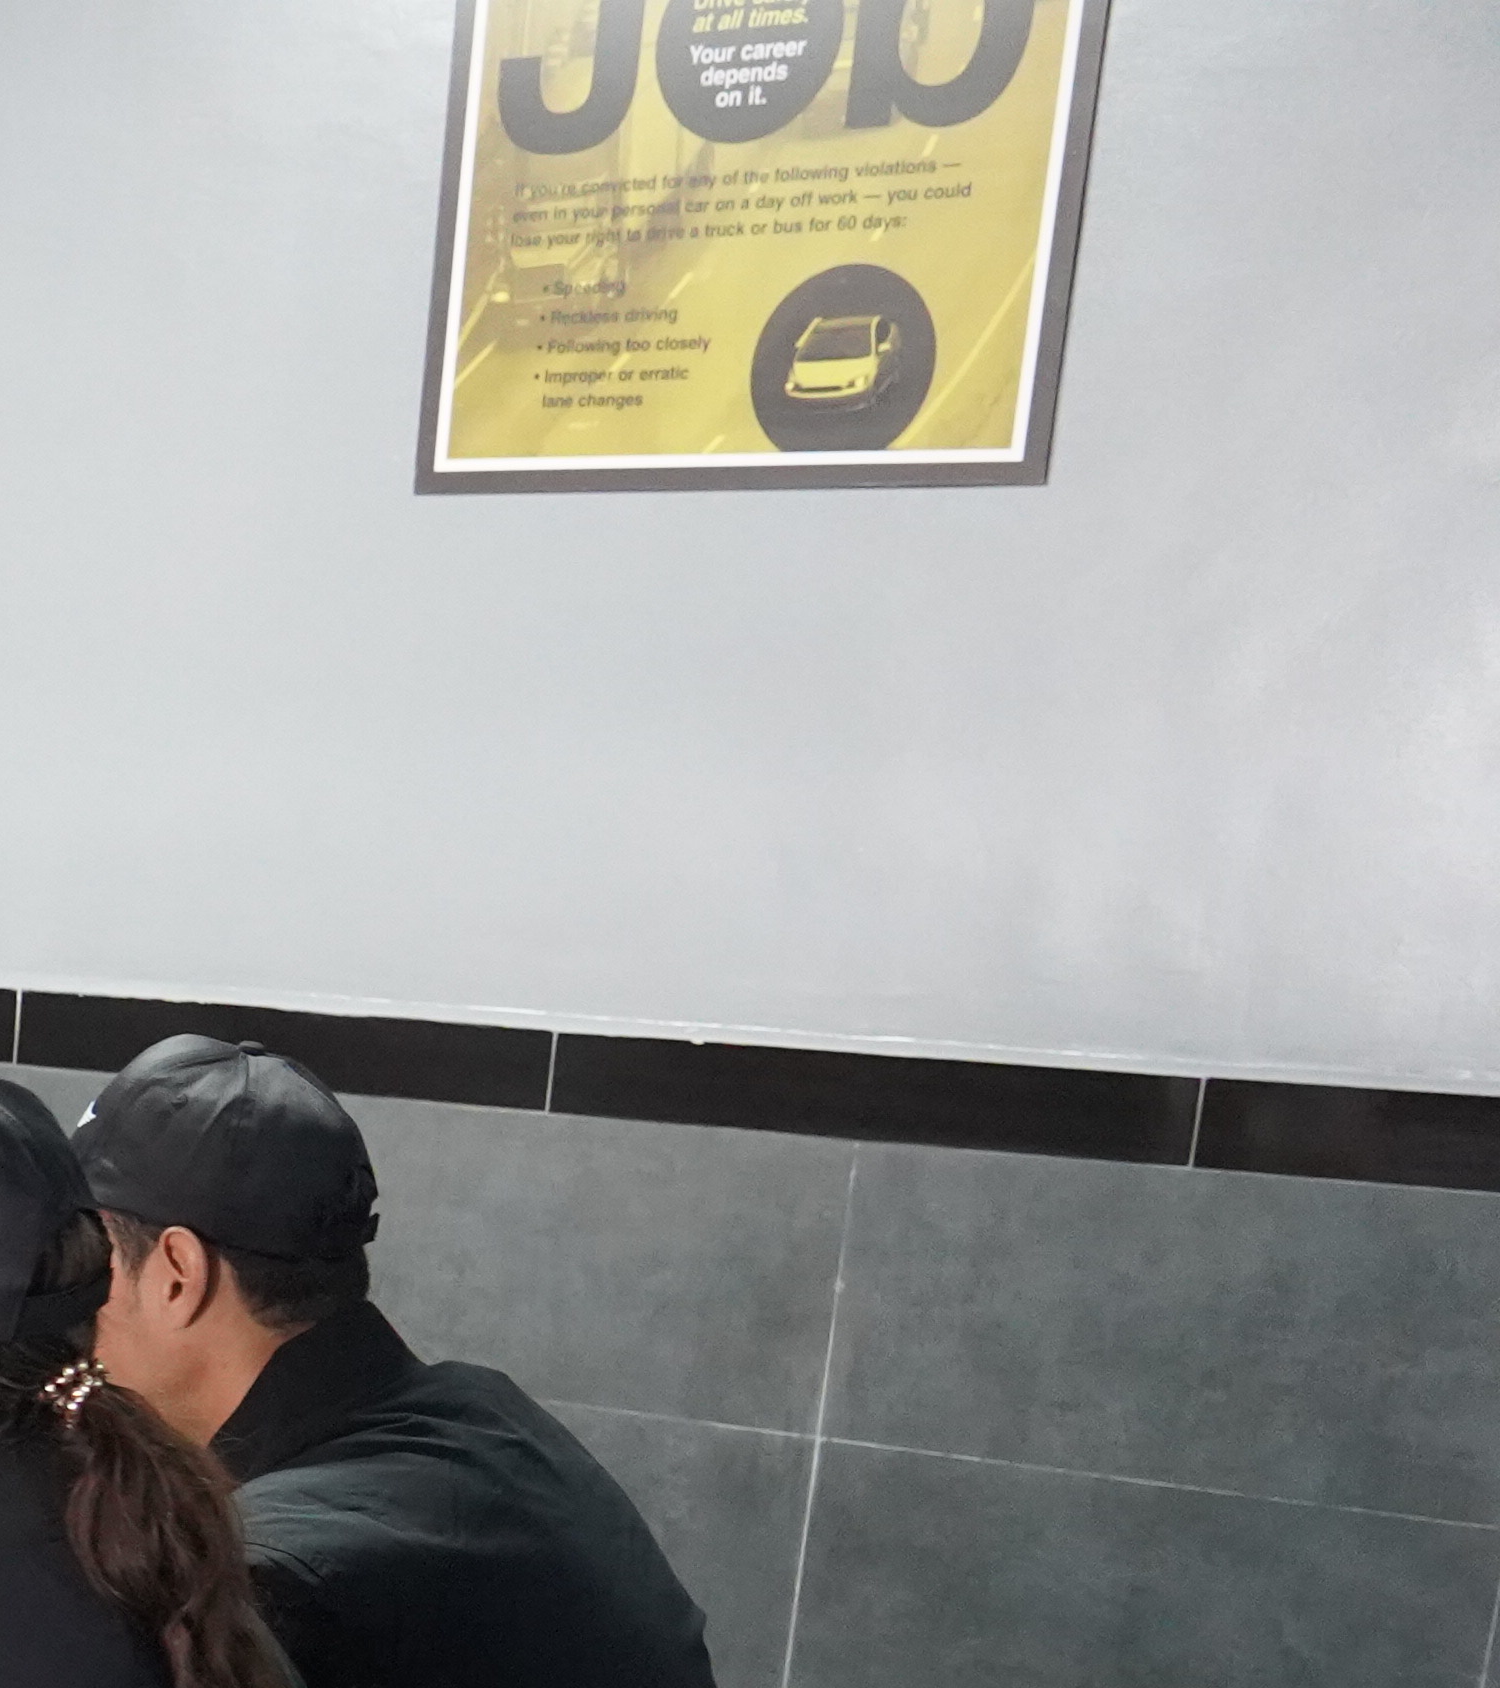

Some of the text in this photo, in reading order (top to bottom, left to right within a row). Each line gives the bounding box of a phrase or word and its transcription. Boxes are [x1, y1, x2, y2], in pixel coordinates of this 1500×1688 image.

[693, 6, 809, 33] at all times.
[690, 39, 808, 65] Your career
[700, 62, 789, 90] depends
[715, 87, 767, 109] on it.
[580, 176, 656, 195] convicted
[662, 175, 683, 190] for
[722, 169, 739, 185] of
[744, 169, 769, 184] the
[774, 165, 849, 183] following
[854, 160, 937, 177] violations
[554, 205, 567, 219] in
[572, 206, 607, 223] your
[684, 200, 708, 213] car
[715, 199, 735, 211] on
[755, 193, 784, 211] day
[790, 191, 813, 207] off
[818, 189, 857, 205] work
[887, 188, 917, 206] you
[924, 182, 972, 200] could
[705, 221, 744, 237] truck
[751, 222, 768, 235] or
[773, 219, 803, 234] bus
[809, 216, 830, 232] for
[624, 307, 678, 325] driving
[547, 335, 712, 356] Following too closely
[544, 366, 690, 386] Improper or erratic
[542, 393, 644, 410] lane changes
